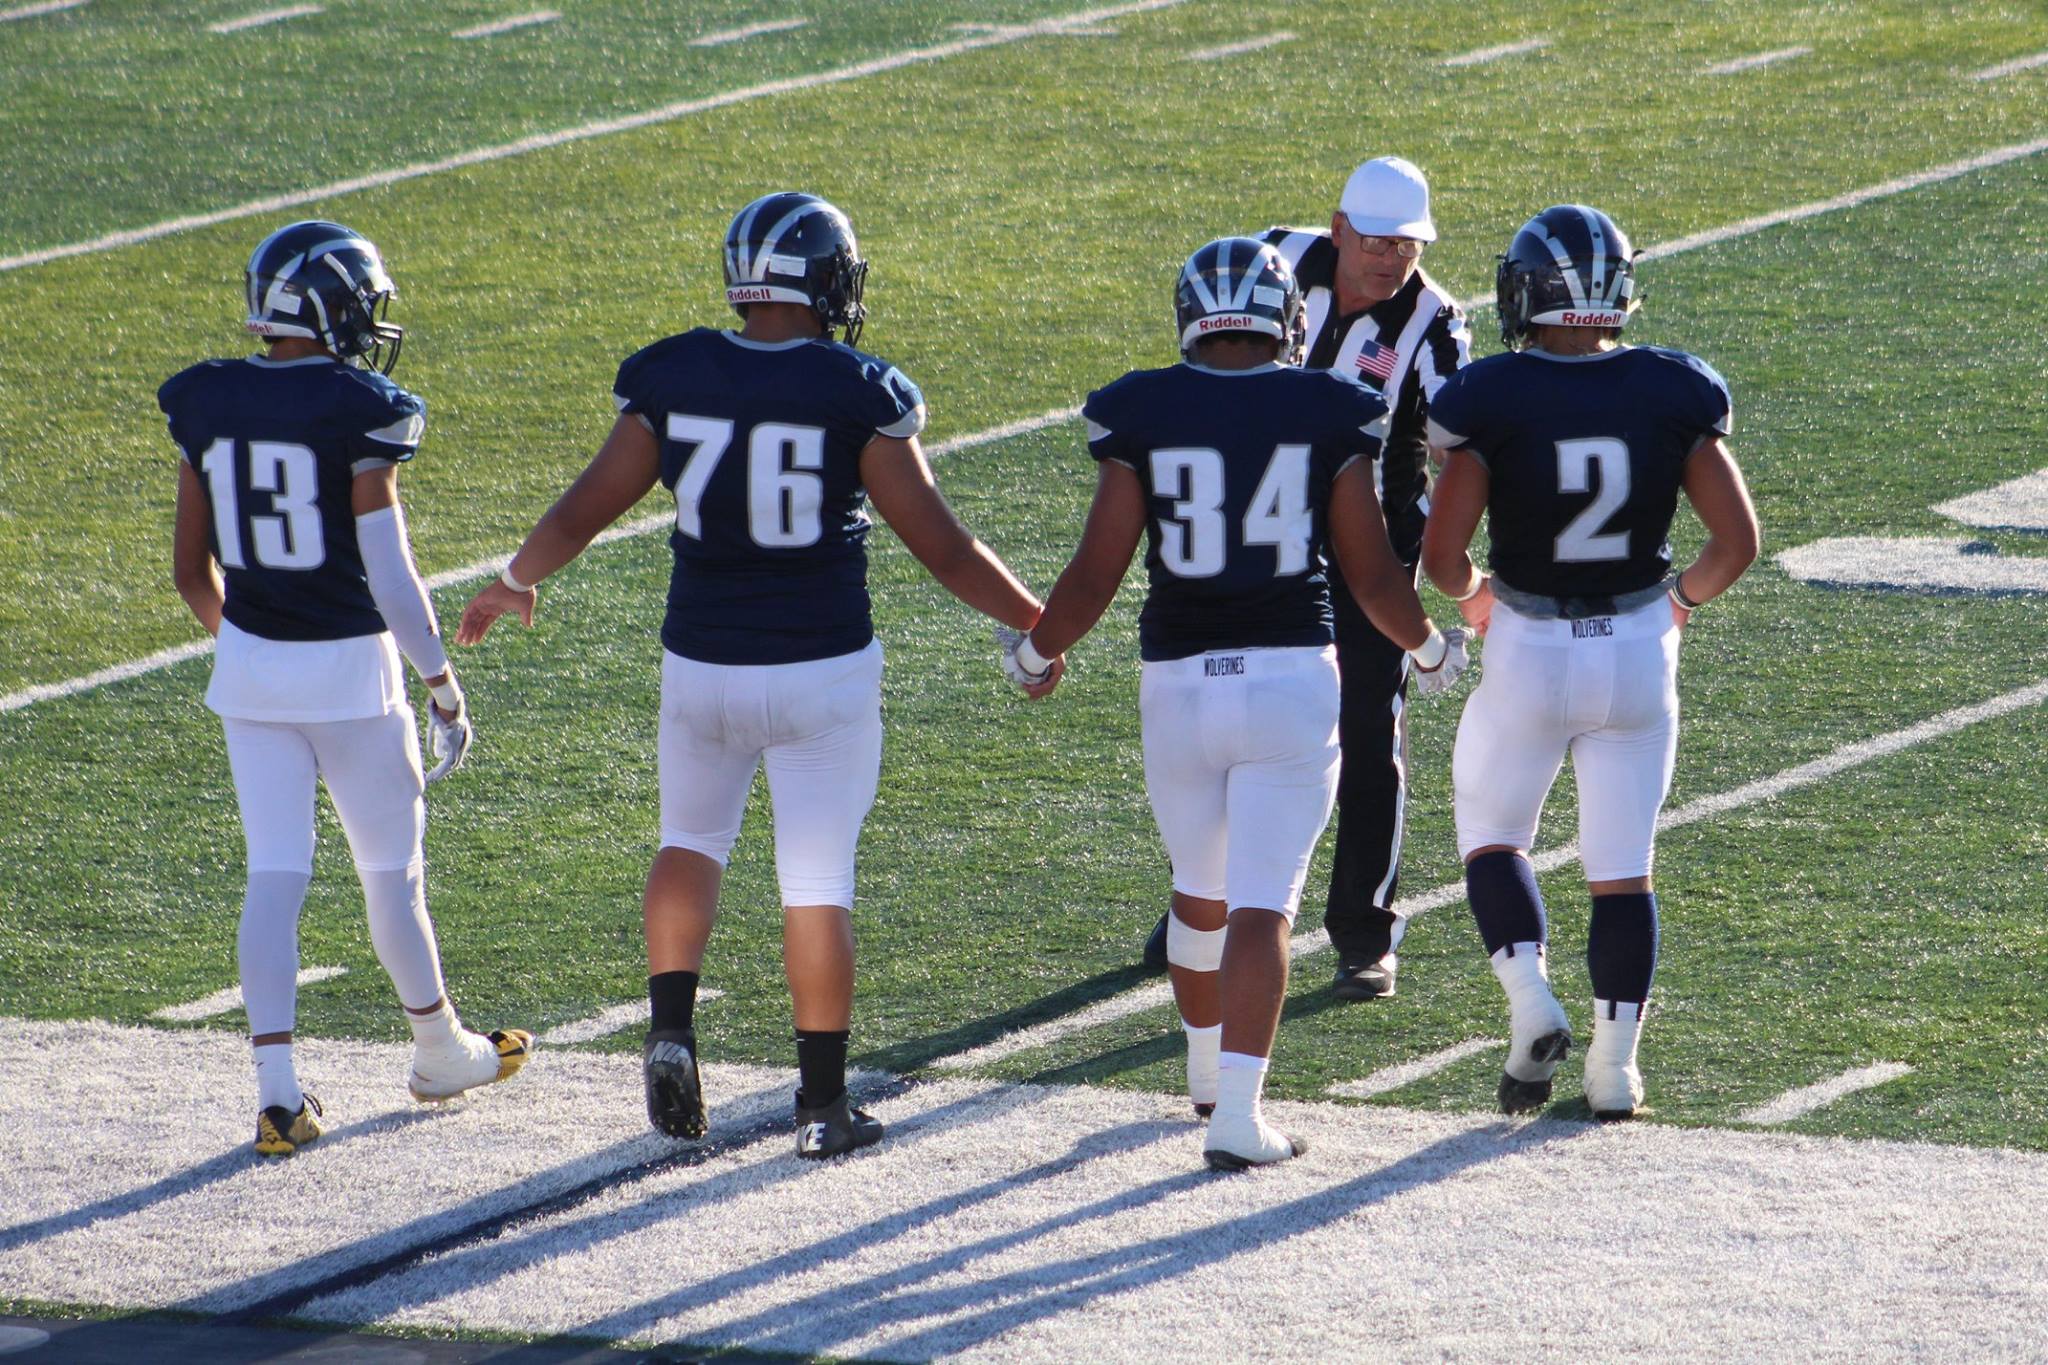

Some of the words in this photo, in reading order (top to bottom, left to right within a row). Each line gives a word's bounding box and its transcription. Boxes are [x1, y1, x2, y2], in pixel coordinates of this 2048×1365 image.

[727, 289, 771, 301] Riddell
[1199, 316, 1253, 331] Riddell
[1562, 312, 1622, 325] Riddell
[667, 411, 827, 549] 76
[202, 437, 326, 571] 13
[1149, 444, 1313, 578] 34
[1553, 436, 1632, 563] 2
[1570, 617, 1613, 639] WOLVERINES
[1204, 656, 1245, 677] WOLVERINES
[796, 1122, 826, 1153] KE
